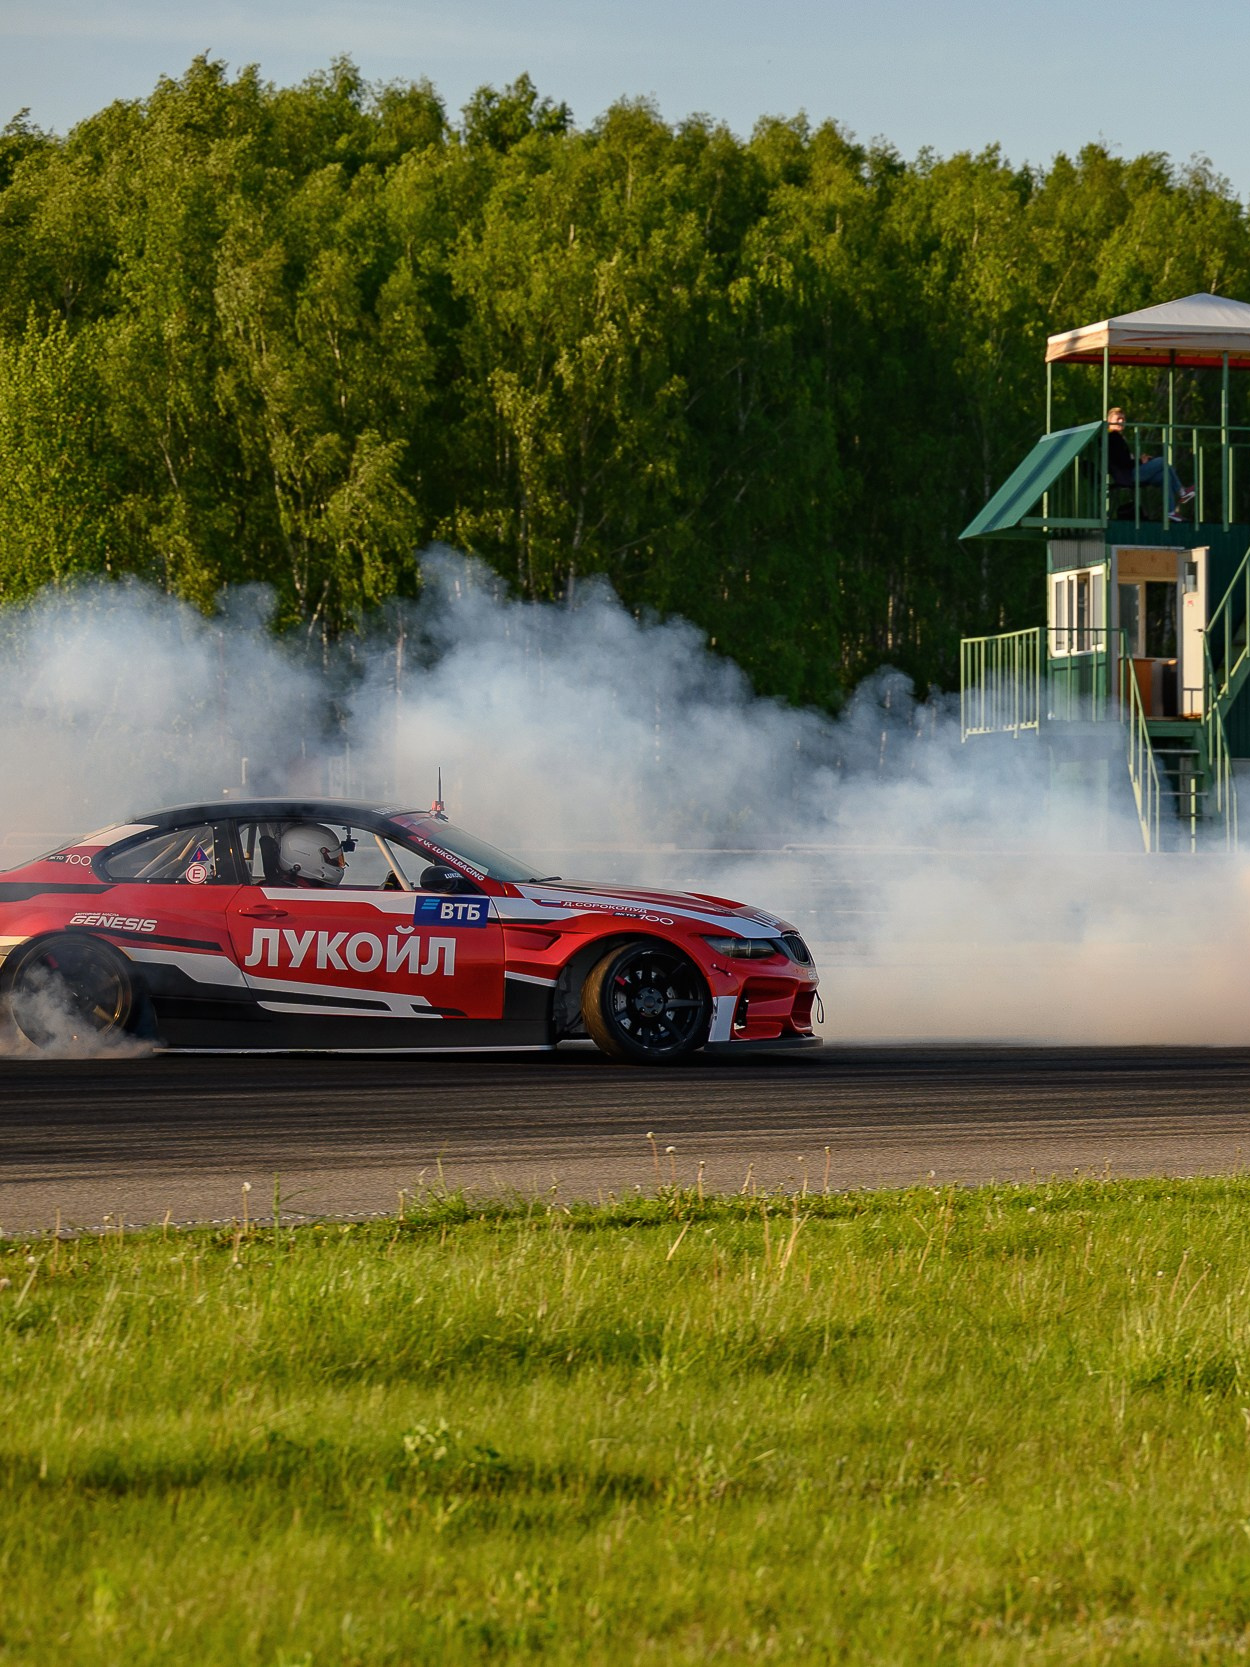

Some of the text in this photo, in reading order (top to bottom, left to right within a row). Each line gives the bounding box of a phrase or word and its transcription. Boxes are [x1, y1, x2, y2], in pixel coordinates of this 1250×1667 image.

[65, 854, 92, 866] 100
[192, 869, 201, 879] E
[440, 903, 481, 921] ВТБ
[562, 901, 648, 914] Д.СОРОКОПУД
[69, 915, 158, 933] GENESIS
[639, 914, 674, 926] 100
[244, 925, 457, 976] ЛУКОЙЛ
